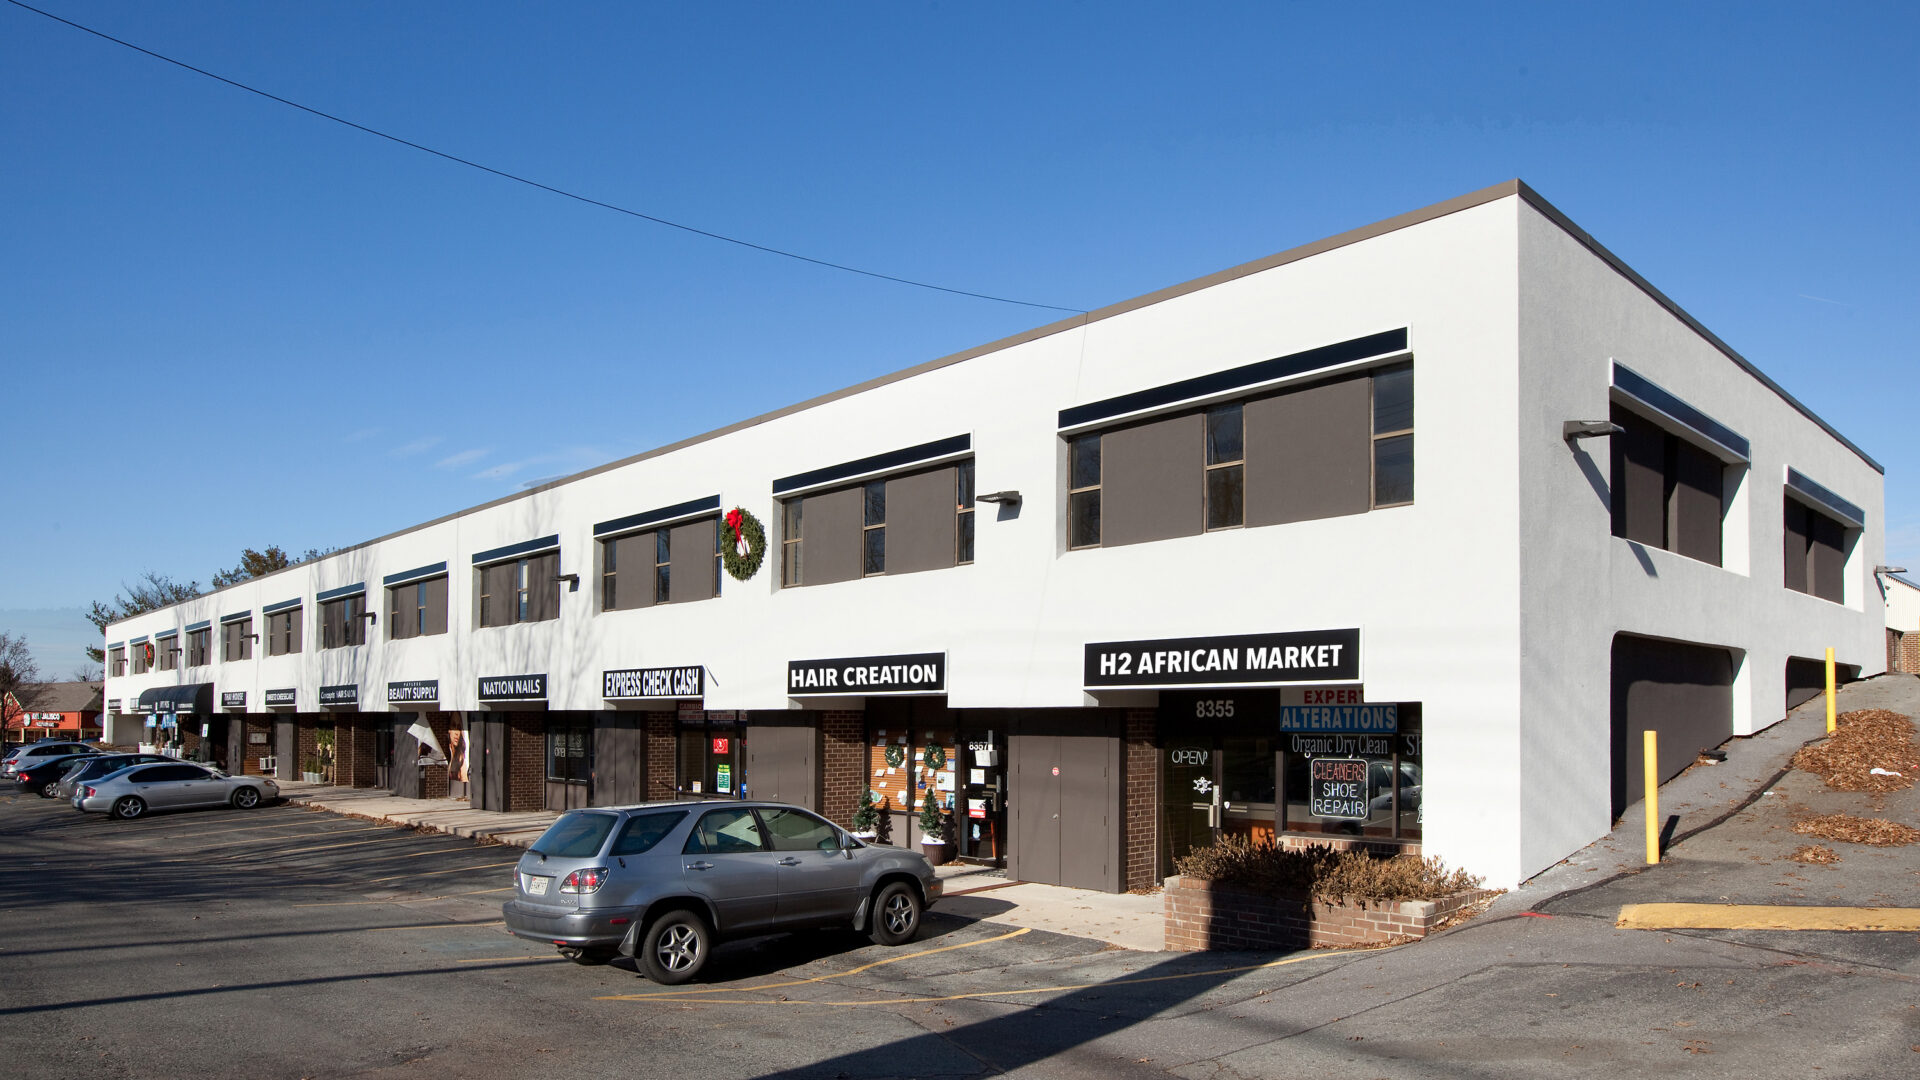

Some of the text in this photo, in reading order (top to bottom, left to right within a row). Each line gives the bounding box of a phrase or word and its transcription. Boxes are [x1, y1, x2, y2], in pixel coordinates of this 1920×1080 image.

[1100, 644, 1343, 676] H2 AFRICAN MARKET
[605, 668, 699, 697] EXPRESS CHECK CASH
[791, 664, 937, 688] HAIR CREATION
[388, 686, 437, 700] BEAUTY SUPPLY
[483, 679, 541, 695] NATION NAILS
[232, 692, 244, 701] HOUSE
[1196, 700, 1235, 718] 8355
[1281, 707, 1396, 729] ALTERATIONS
[968, 742, 988, 751] 8357
[1291, 733, 1388, 759] Organic Dry Clean
[1171, 749, 1208, 765] OPEN
[1313, 761, 1366, 781] CLEANERS
[1322, 783, 1358, 798] SHOE
[1313, 799, 1365, 816] REPAIR
